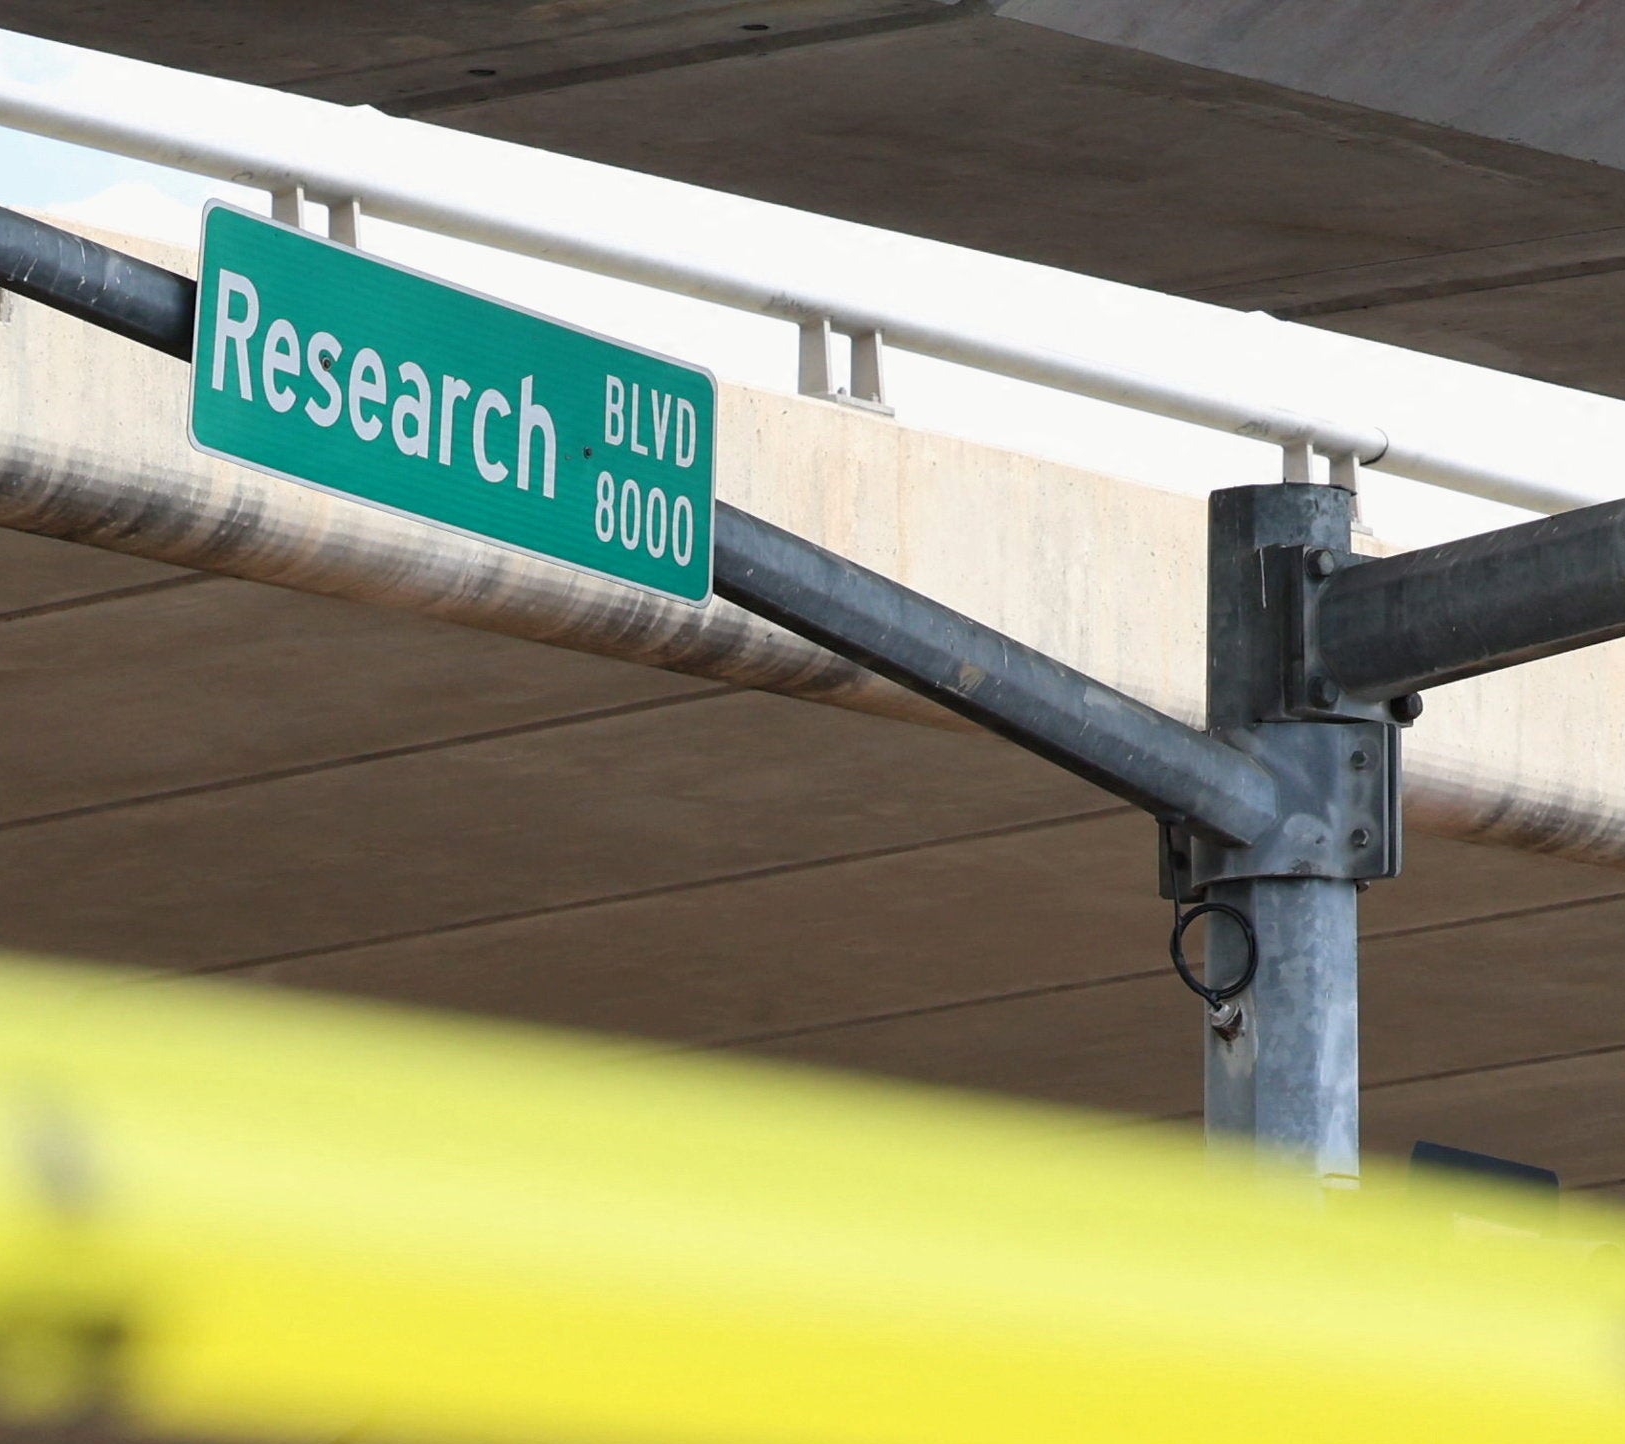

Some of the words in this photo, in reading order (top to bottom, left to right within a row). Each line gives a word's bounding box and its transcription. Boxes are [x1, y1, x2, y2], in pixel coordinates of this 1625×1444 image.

[211, 267, 557, 500] Research
[603, 373, 697, 469] BLVD
[594, 471, 694, 567] 8000
